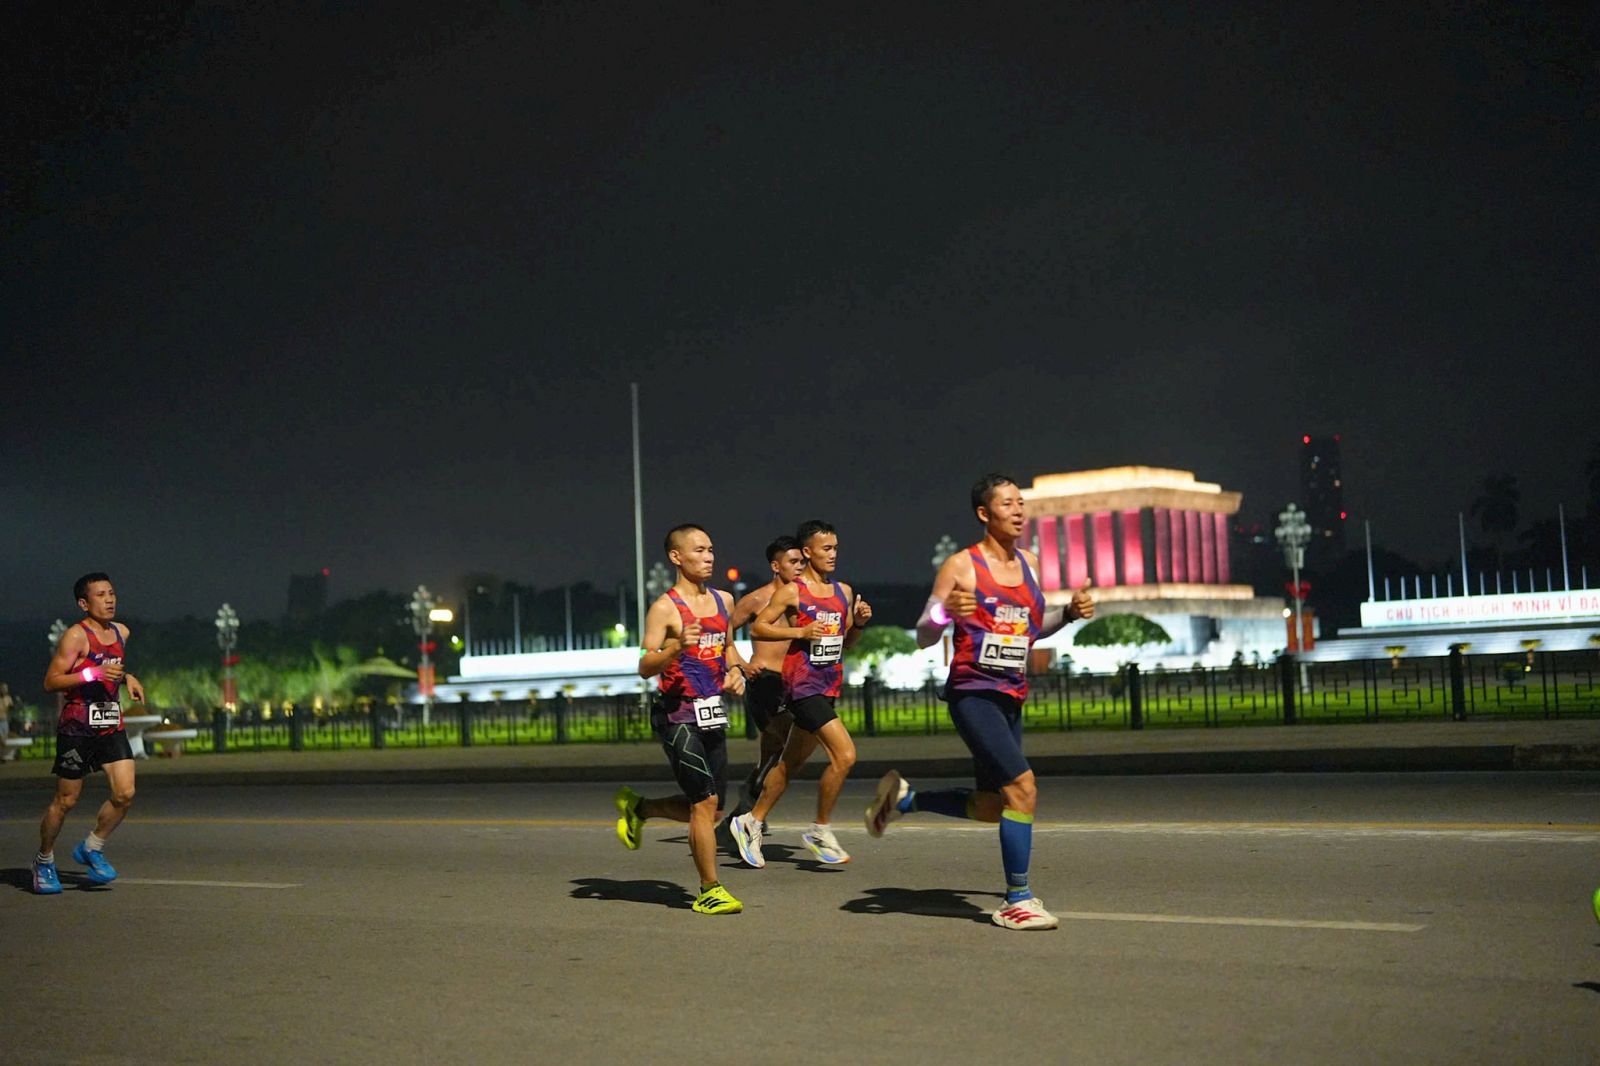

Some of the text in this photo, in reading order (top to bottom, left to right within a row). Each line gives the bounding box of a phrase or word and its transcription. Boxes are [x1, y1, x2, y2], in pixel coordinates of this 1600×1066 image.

[1512, 600, 1552, 613] MINH
[985, 645, 998, 658] A
[93, 711, 104, 720] A
[700, 709, 711, 719] B
